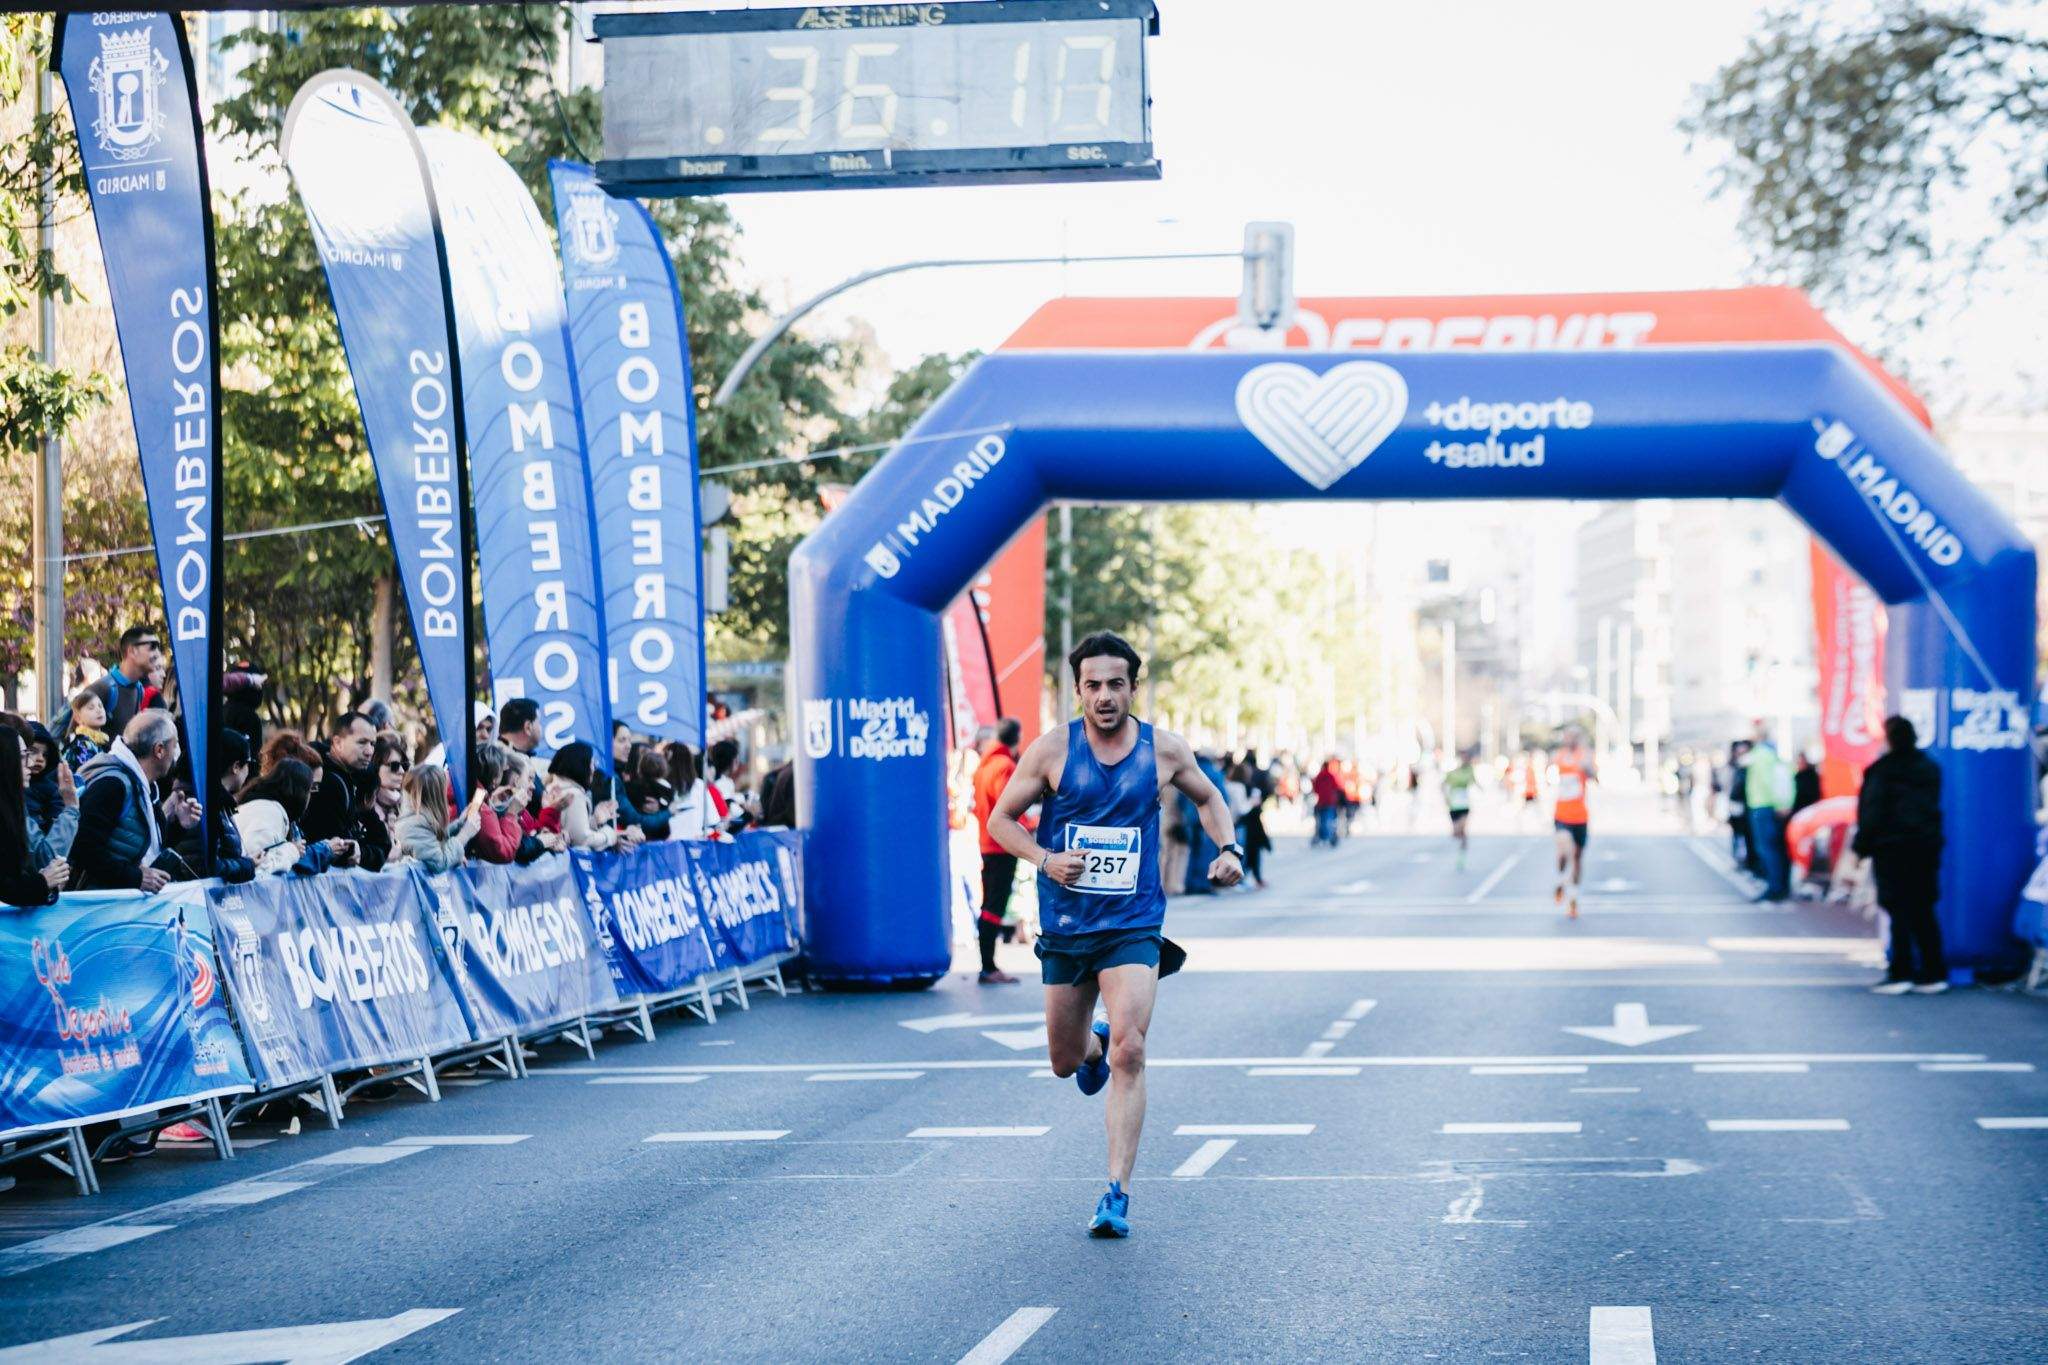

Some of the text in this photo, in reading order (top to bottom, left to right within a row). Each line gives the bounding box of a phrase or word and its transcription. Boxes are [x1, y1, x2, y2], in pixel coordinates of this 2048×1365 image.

[680, 159, 728, 176] hour
[1066, 144, 1109, 160] sec.
[1423, 396, 1594, 437] +deporte
[1423, 434, 1546, 468] +salud
[897, 434, 1006, 546] MADRID
[1847, 454, 1964, 567] MADRID
[278, 919, 431, 1010] BOMBEROS
